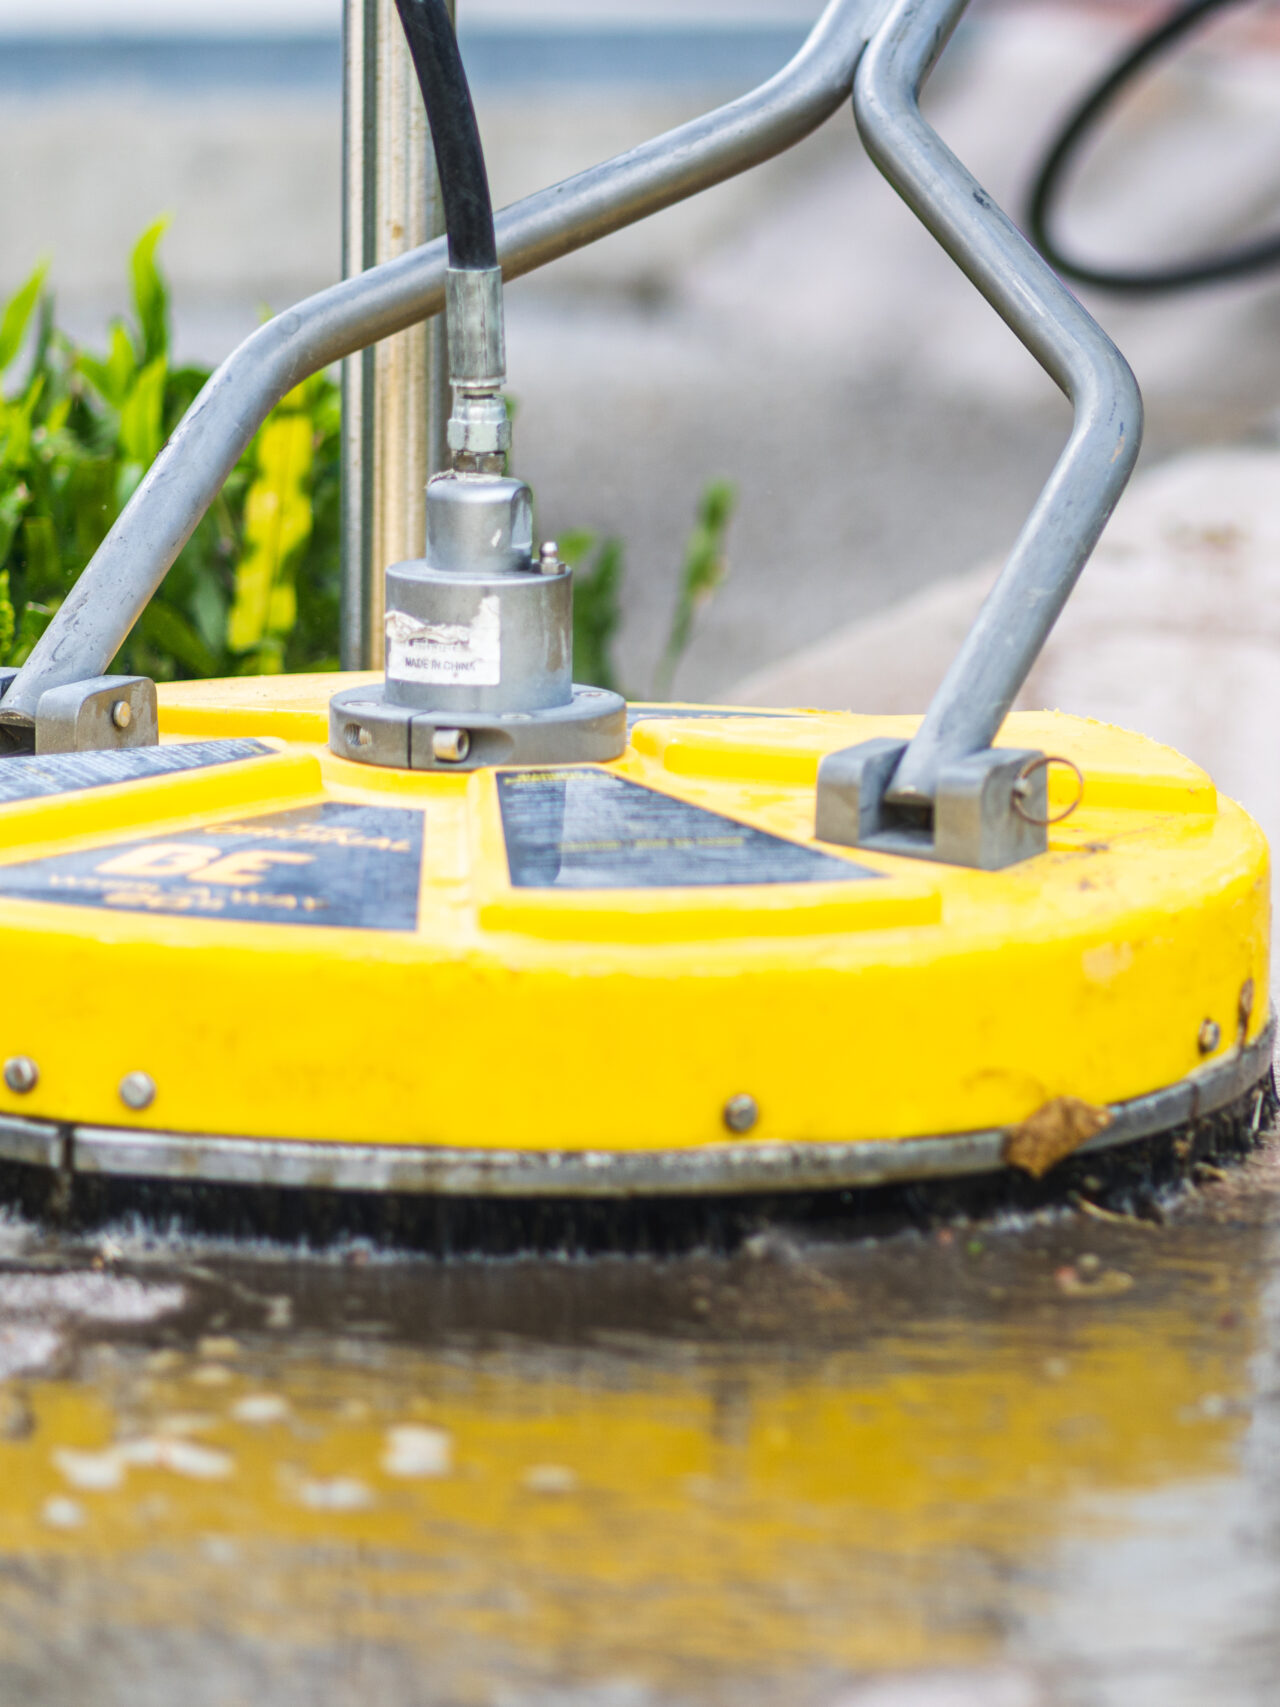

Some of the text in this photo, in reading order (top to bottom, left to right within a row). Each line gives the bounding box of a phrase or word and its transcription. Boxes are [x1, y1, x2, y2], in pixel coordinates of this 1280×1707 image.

[405, 656, 476, 671] MADE IN CHINA
[94, 843, 318, 885] BE
